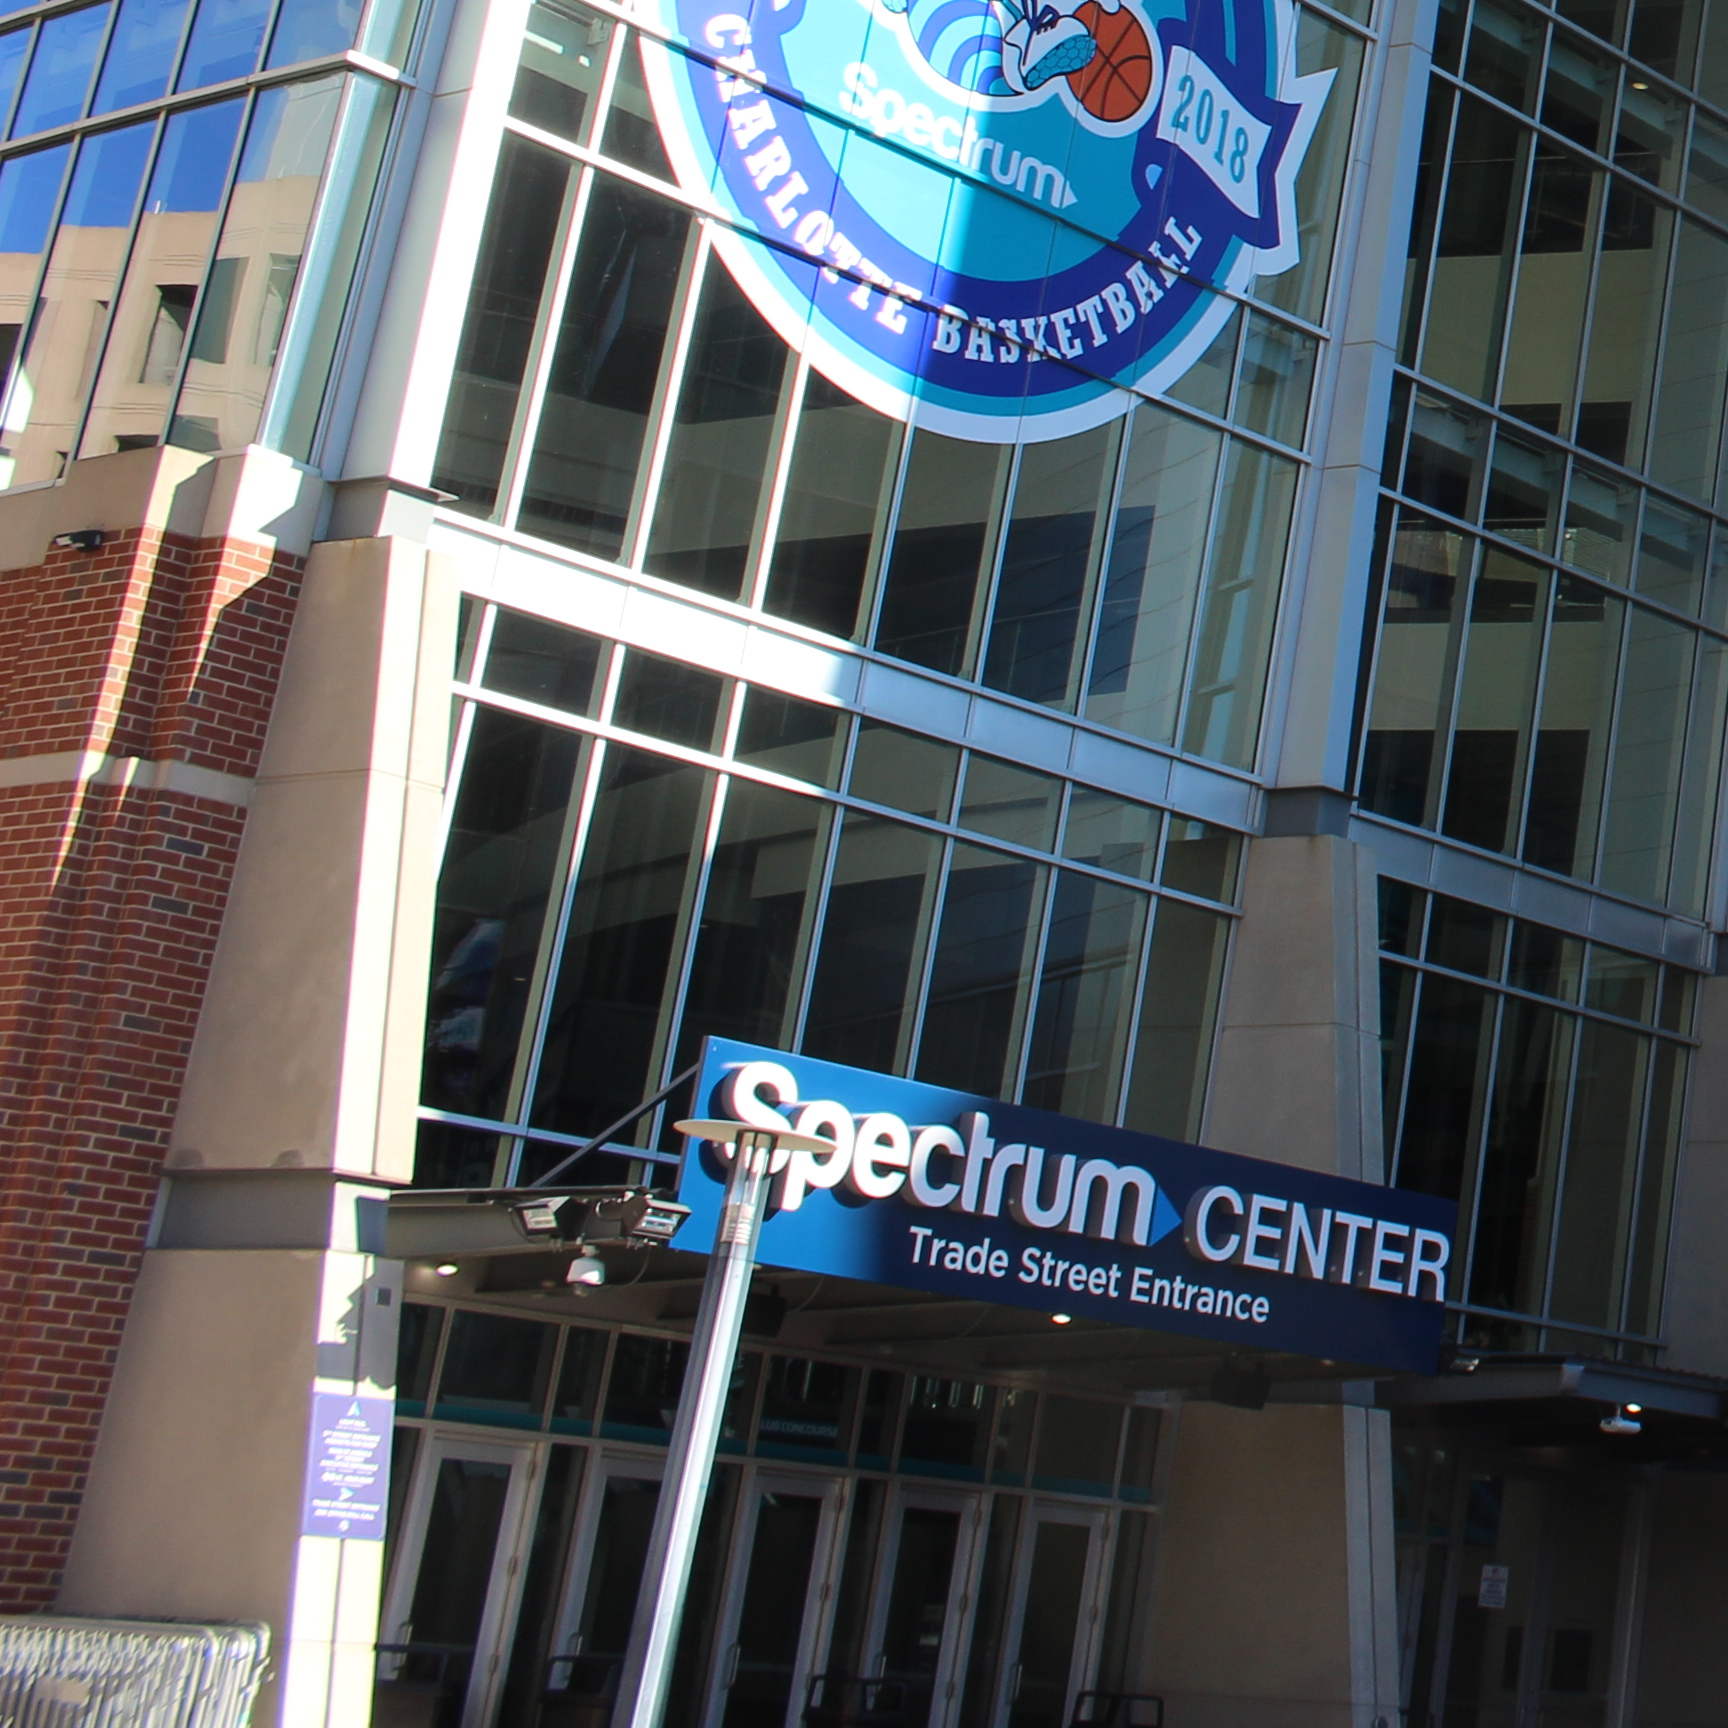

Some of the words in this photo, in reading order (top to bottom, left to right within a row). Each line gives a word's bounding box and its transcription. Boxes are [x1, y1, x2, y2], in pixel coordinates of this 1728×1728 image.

[705, 13, 922, 334] CHARLOTTE
[838, 61, 1065, 209] Spectrum
[1170, 74, 1248, 184] 2018
[932, 216, 1202, 363] BASKETBALL
[725, 1061, 1156, 1247] Spectrum
[1196, 1185, 1450, 1302] CENTER
[909, 1225, 1009, 1278] Trade
[1018, 1246, 1121, 1299] Street
[1129, 1266, 1270, 1323] Entrance
